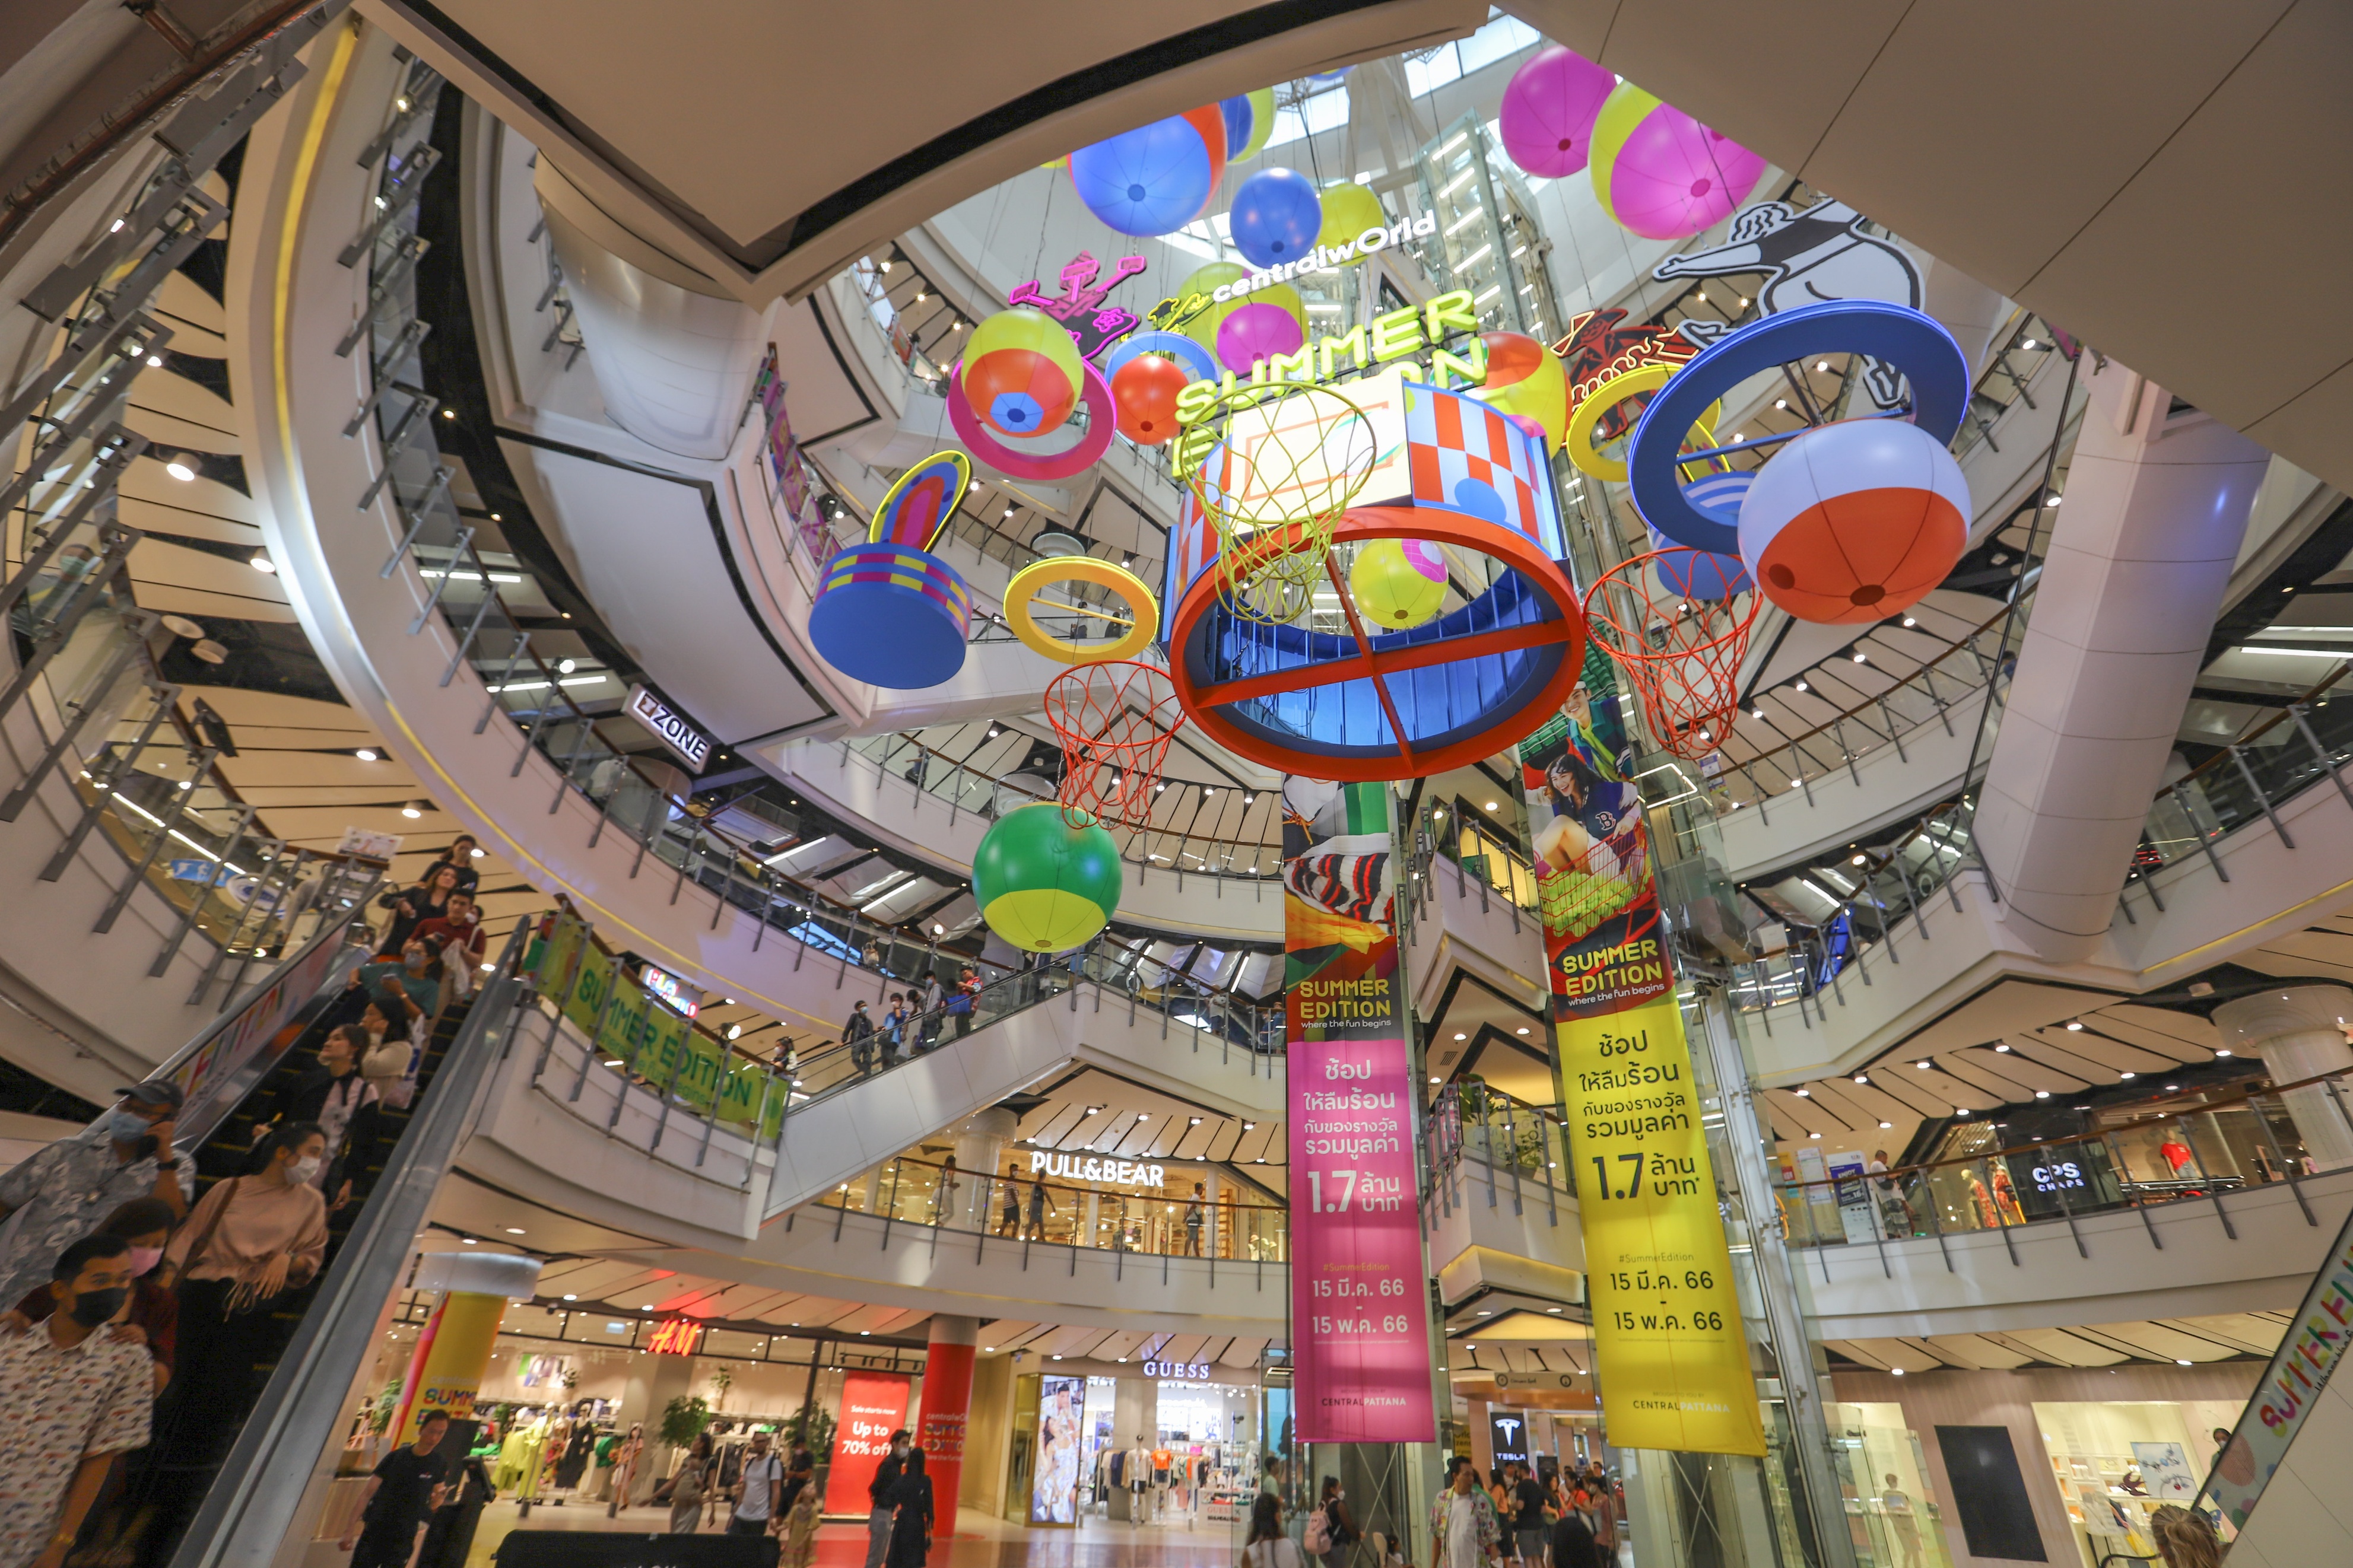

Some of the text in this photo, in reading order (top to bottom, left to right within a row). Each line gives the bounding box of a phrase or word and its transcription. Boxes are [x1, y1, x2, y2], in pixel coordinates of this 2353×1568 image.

[1213, 209, 1437, 304] centralwOrld
[1174, 288, 1479, 425] SUMMER
[1563, 939, 1659, 974] SUMMER
[1300, 979, 1390, 998] SUMMER
[1566, 961, 1663, 997] EDITION
[1568, 984, 1665, 1007] where the fun begins
[1300, 1000, 1392, 1019] EDITION
[1362, 1019, 1392, 1029] begins
[1599, 1030, 1648, 1057] ช้อป
[1326, 1058, 1371, 1080] ช้อป
[1579, 1062, 1679, 1092] ให้ลืมร้อน
[1303, 1087, 1395, 1111] ให้ลืมร้อน
[1583, 1092, 1685, 1117] กับของรางวัล
[1304, 1118, 1398, 1133] กับของรางวัล
[1587, 1109, 1690, 1140] รวมมูลค่า
[1306, 1133, 1399, 1160] รวมมูลค่า
[1031, 1151, 1164, 1187] PULL&BEAR
[1592, 1153, 1695, 1200] 1.7 ล้าน
[2032, 1162, 2081, 1184] CPS
[1307, 1170, 1400, 1213] 1.7 ล้าน
[1323, 1262, 1390, 1272] #SummerEdition
[1620, 1252, 1694, 1263] #SummerEdition
[1313, 1277, 1405, 1297] 15 มี.ค. 66
[1610, 1270, 1714, 1290] 15 มี.ค. 66
[1313, 1315, 1408, 1334] 15 พ.ค. 66
[1614, 1312, 1723, 1330] 15 พ.ค. 66
[647, 1319, 701, 1357] H&M
[1143, 1362, 1210, 1379] GUESS
[2260, 1315, 2340, 1438] SUMMER
[1322, 1397, 1406, 1406] CENTRALPATTANA
[1633, 1401, 1730, 1413] CENTRALPATTANA
[852, 1421, 889, 1439] Up to
[842, 1440, 893, 1456] 70% off
[1496, 1452, 1526, 1461] TESLA
